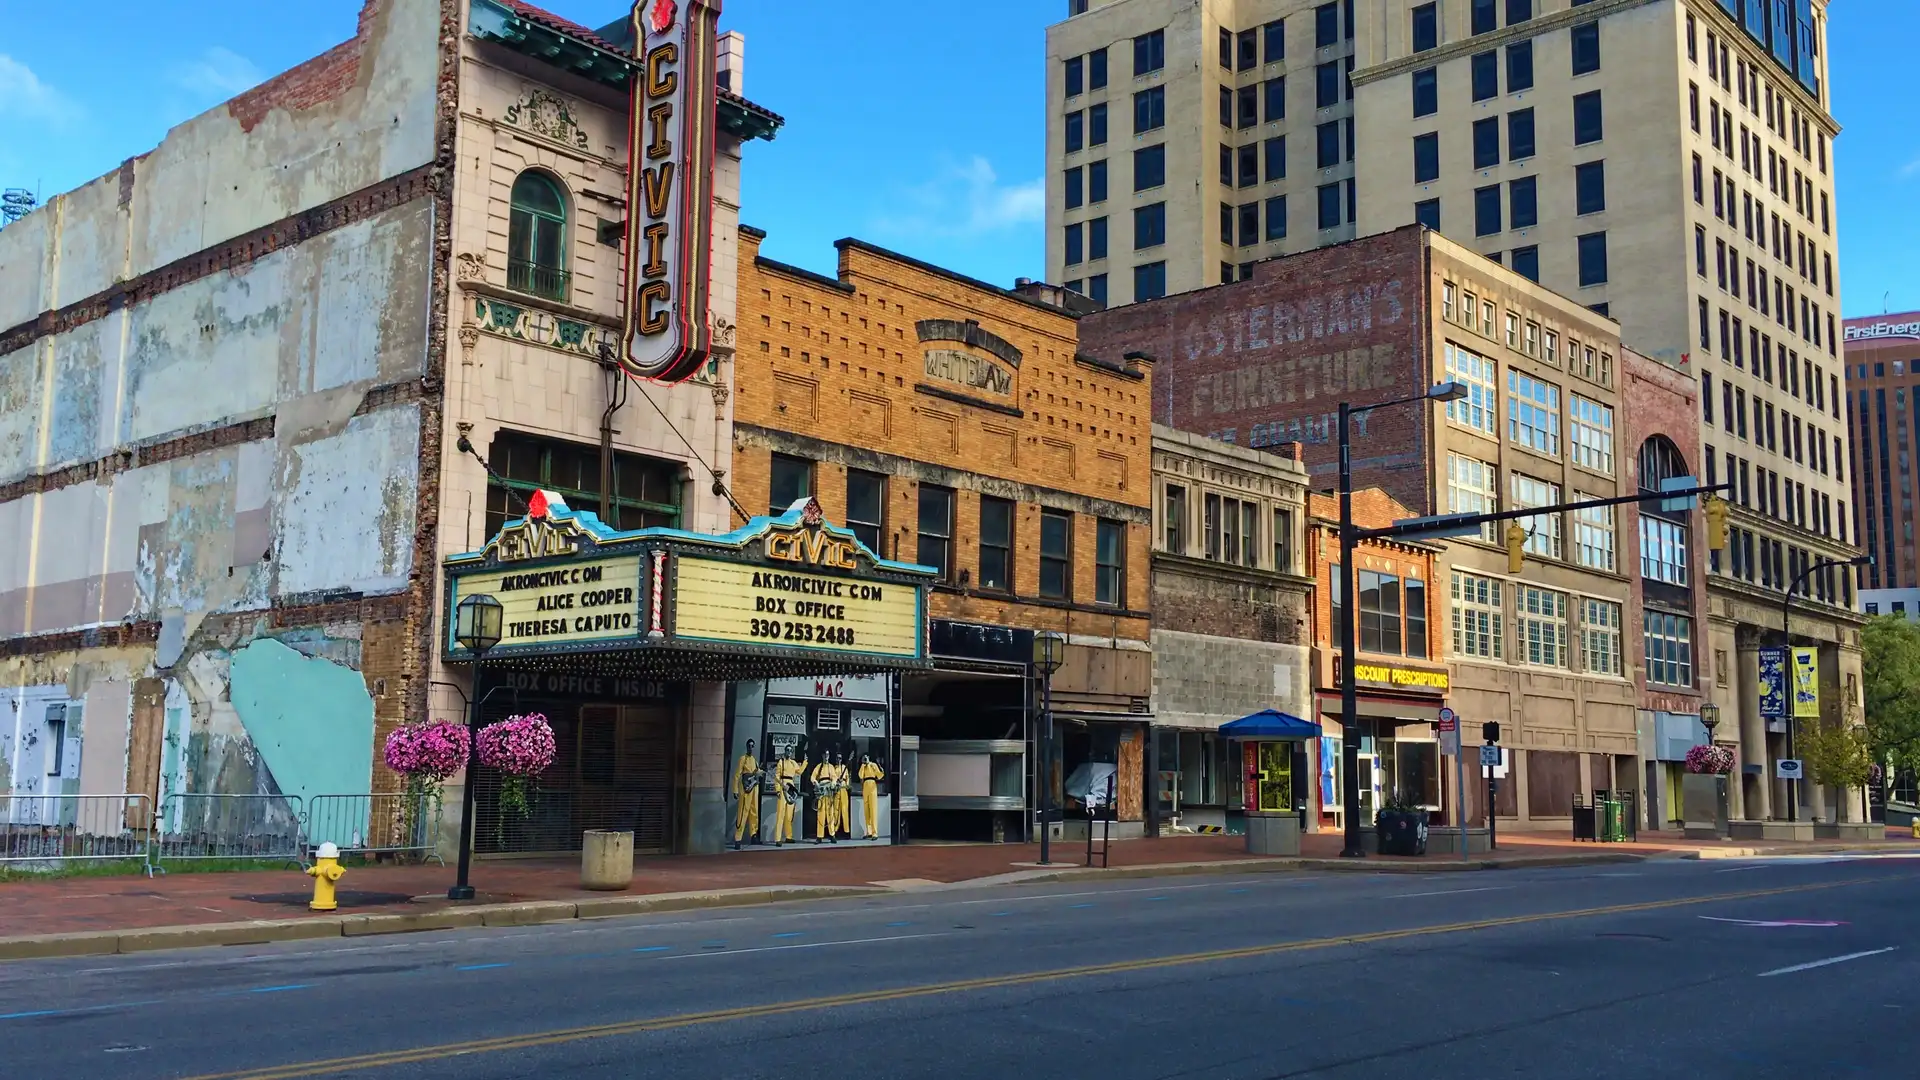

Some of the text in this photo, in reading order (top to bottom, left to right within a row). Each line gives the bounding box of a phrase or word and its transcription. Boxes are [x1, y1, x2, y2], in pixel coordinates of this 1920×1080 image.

[636, 41, 679, 337] CIVIC
[1844, 322, 1920, 339] FirstEnerg
[497, 520, 579, 562] CIVIC
[765, 528, 857, 570] CIVIC
[536, 587, 632, 611] ALICE COOPER
[756, 596, 845, 620] BOX OFFICE
[509, 613, 631, 637] THERESA CAPUTO
[750, 618, 855, 645] 330 253 2488
[506, 672, 665, 698] BOX OFFICE INSIDE
[1354, 665, 1391, 683] ISCOUNT
[1392, 668, 1448, 688] PRESCRIPTIONS
[855, 717, 881, 730] TACOS
